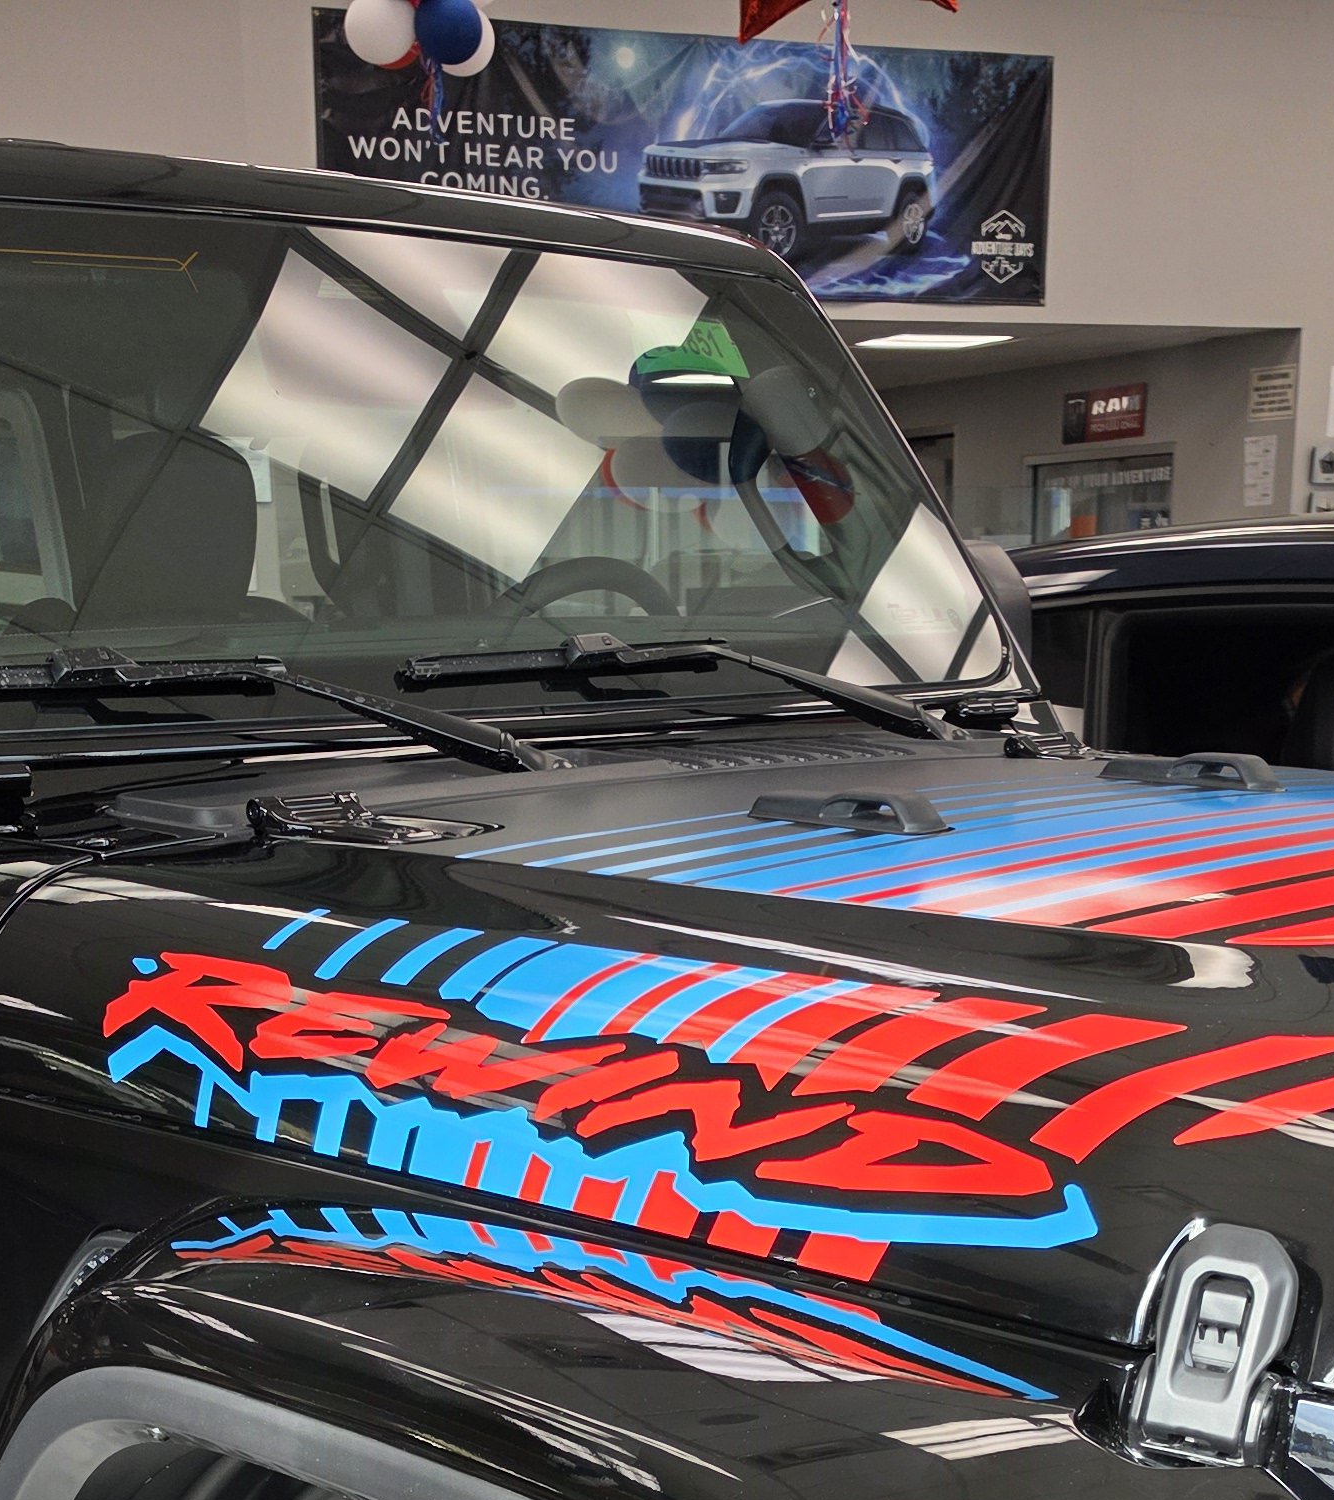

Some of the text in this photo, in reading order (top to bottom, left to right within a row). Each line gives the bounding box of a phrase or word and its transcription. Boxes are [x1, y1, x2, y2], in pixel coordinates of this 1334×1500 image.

[392, 107, 576, 141] ADVENTURE
[348, 135, 618, 174] WON'T HEAR YOU
[420, 171, 549, 200] COMING.
[1091, 395, 1141, 415] RAM
[103, 951, 1053, 1196] REWIND
